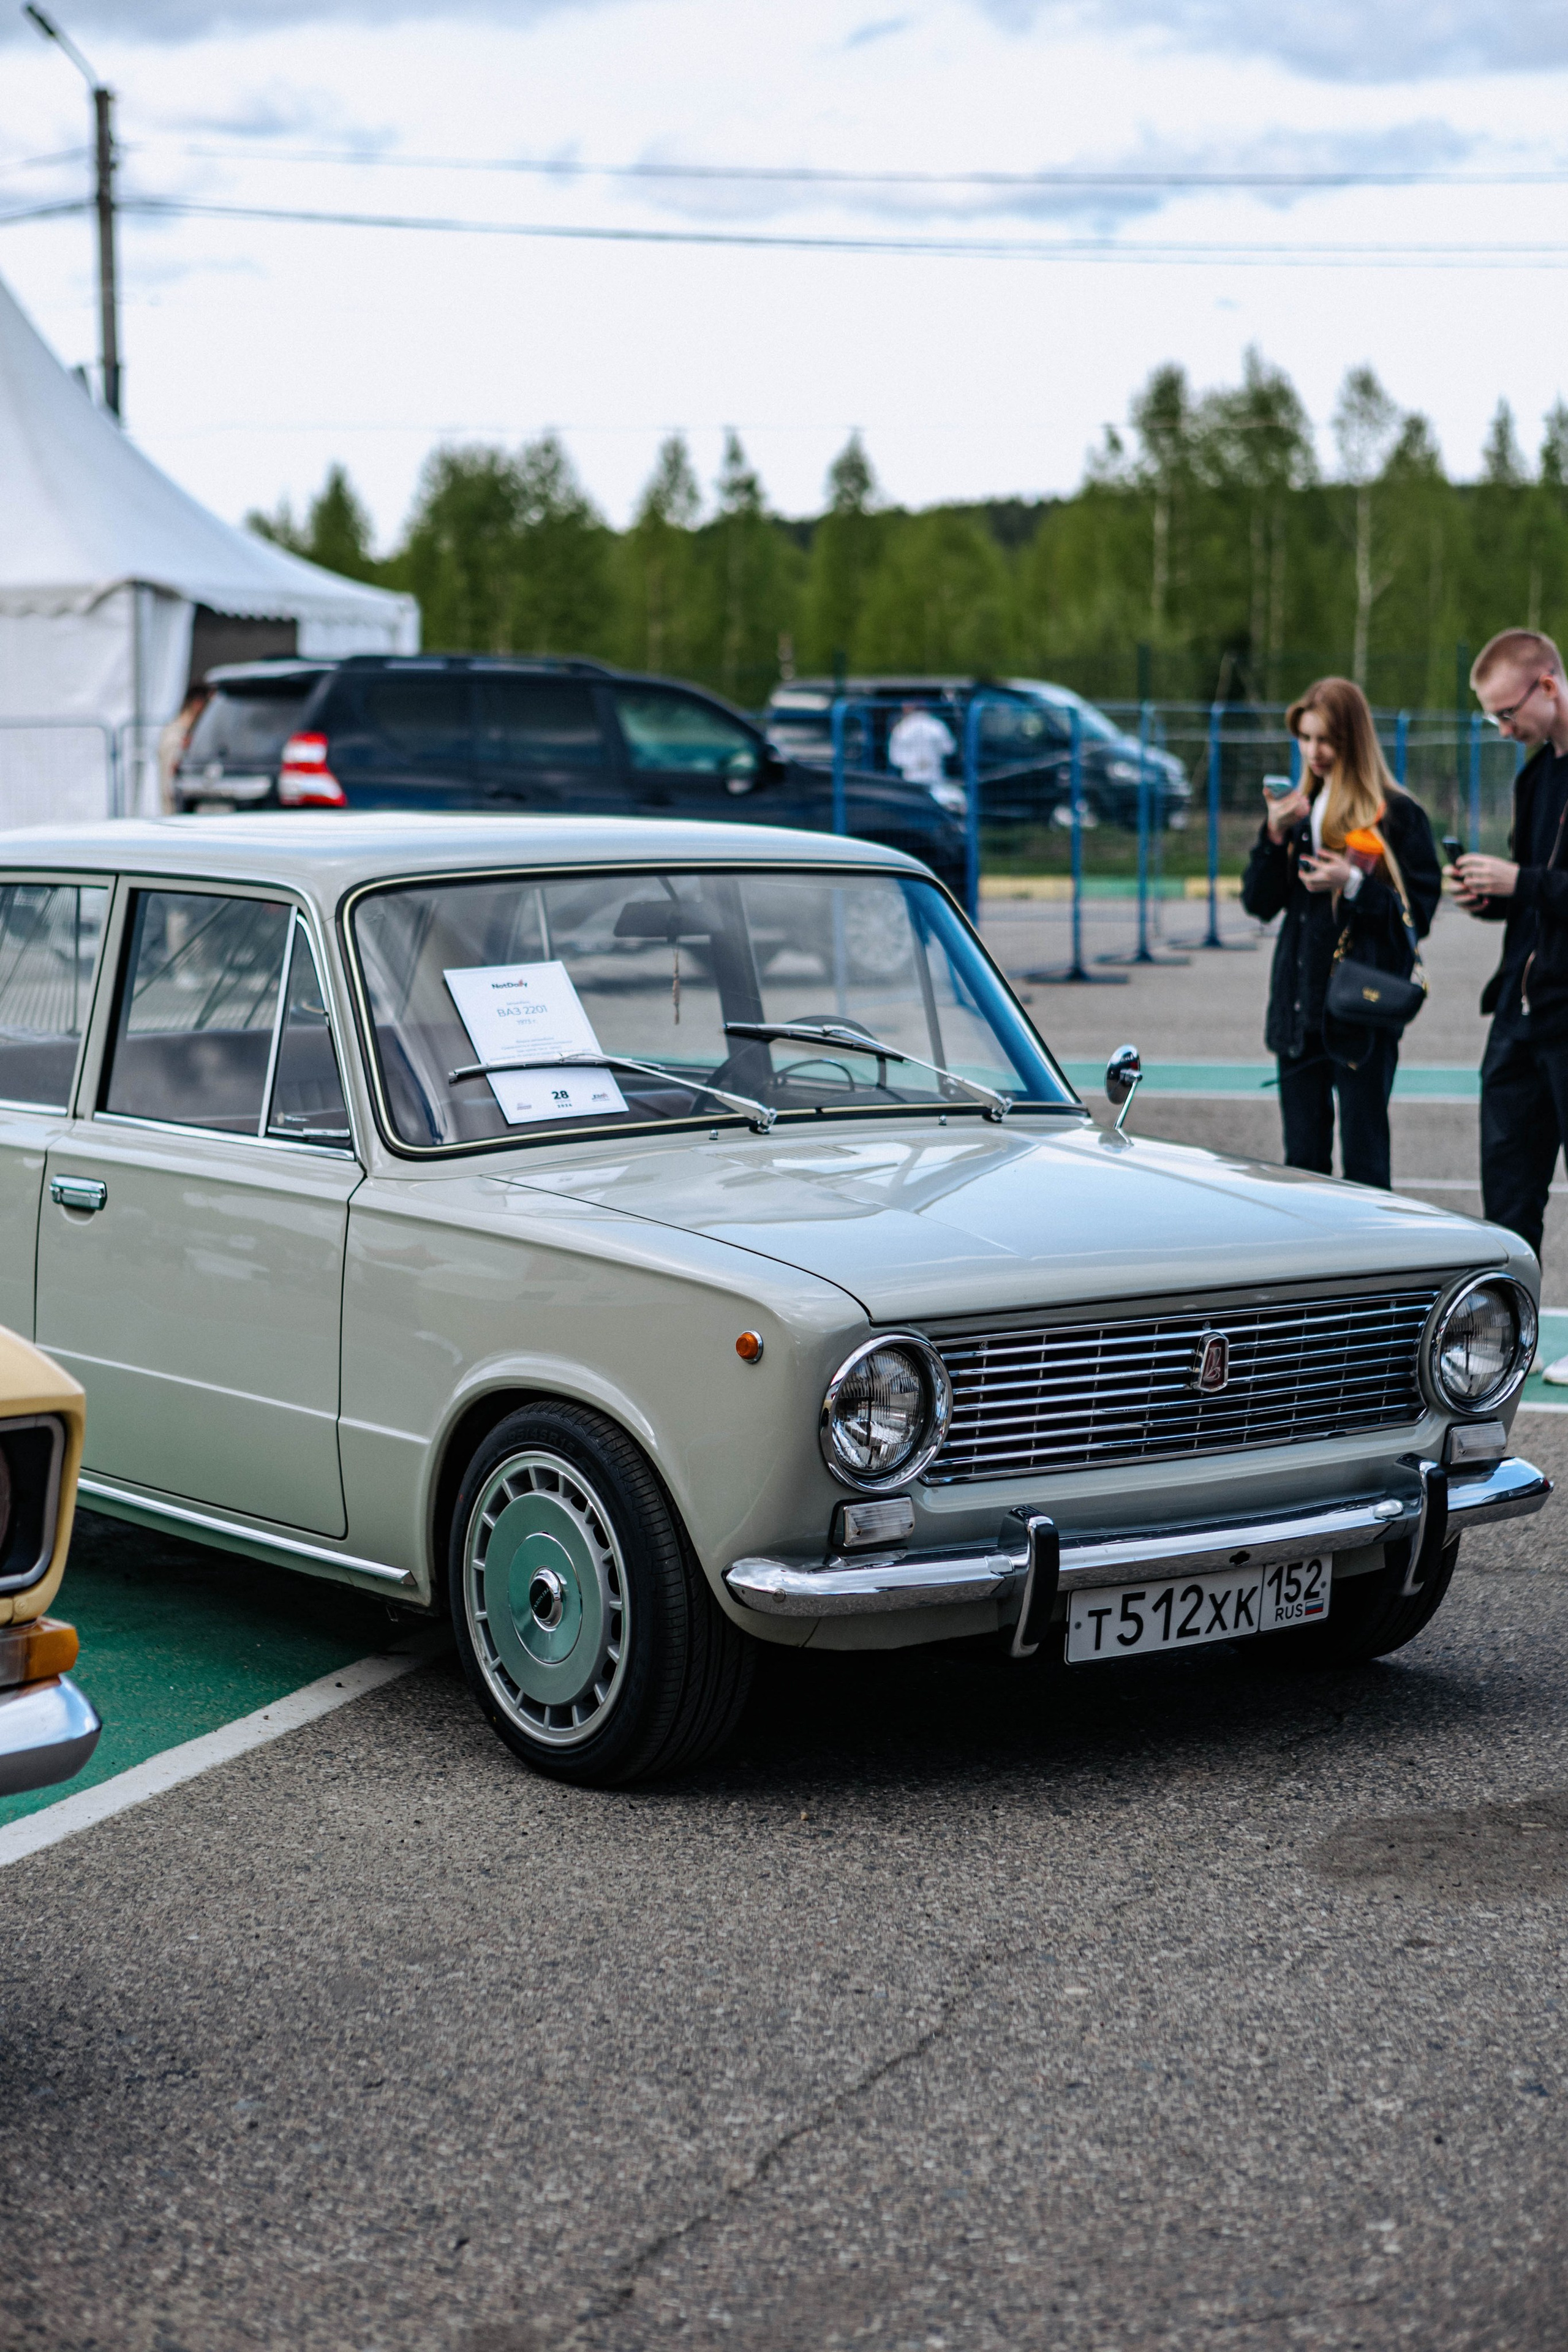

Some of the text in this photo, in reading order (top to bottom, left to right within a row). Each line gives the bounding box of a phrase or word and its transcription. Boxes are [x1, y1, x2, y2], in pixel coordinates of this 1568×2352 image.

[497, 1005, 548, 1017] ВАЗ 2201
[551, 1090, 569, 1099] 28
[1088, 1559, 1322, 1651] Т512ХК 152
[1275, 1603, 1303, 1622] RUS
